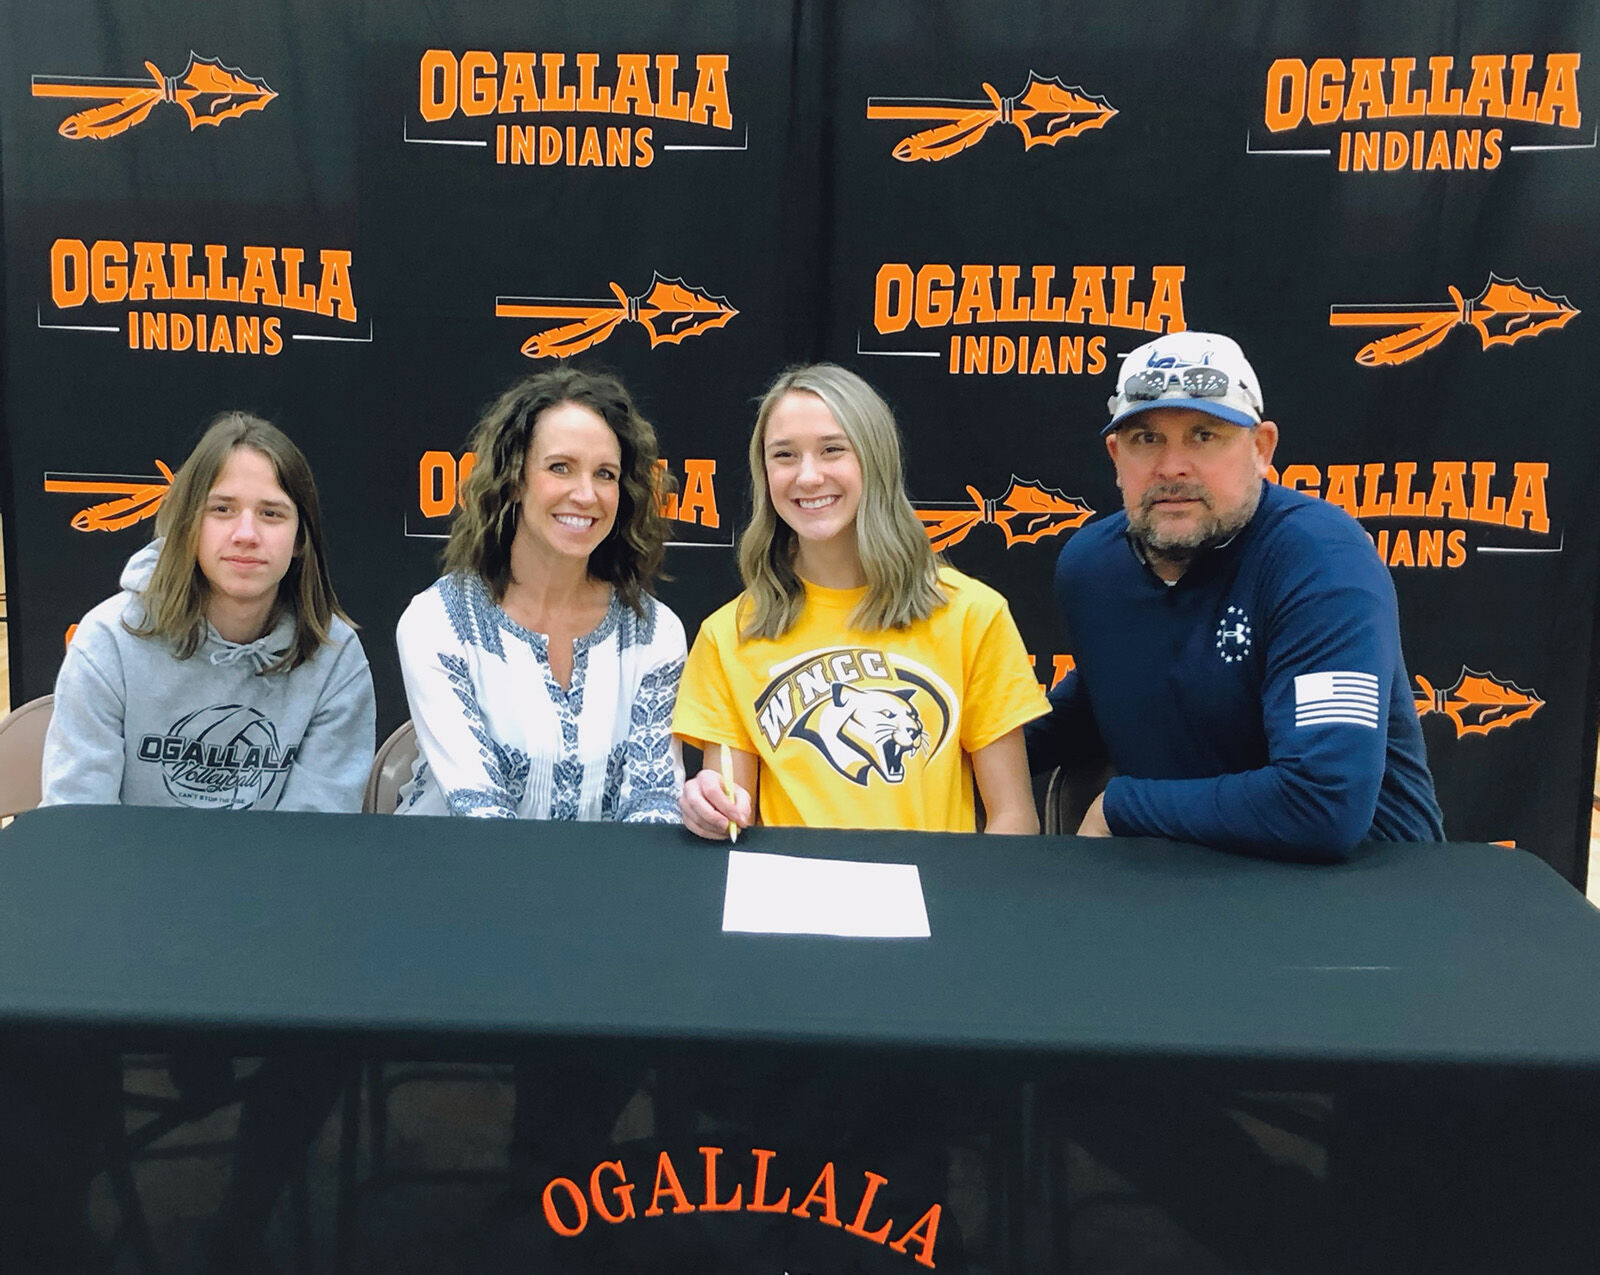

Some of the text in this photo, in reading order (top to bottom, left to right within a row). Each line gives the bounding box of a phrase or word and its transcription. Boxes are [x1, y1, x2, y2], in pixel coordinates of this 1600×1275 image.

[419, 48, 732, 130] OGALLALA
[1264, 52, 1582, 132] OGALLALA
[495, 125, 654, 168] INDIANS
[1337, 128, 1502, 172] INDIANS
[50, 238, 357, 322] OGALLALA
[873, 263, 1187, 335] OGALLALA
[128, 311, 283, 355] INDIANS
[949, 335, 1107, 375] INDIANS
[1268, 461, 1550, 534] GALLALA
[1366, 529, 1467, 568] IANS
[757, 650, 891, 752] WNCC
[137, 735, 299, 771] OGALLALA
[170, 758, 262, 793] Volleyball
[541, 1146, 942, 1269] OGALLALA
